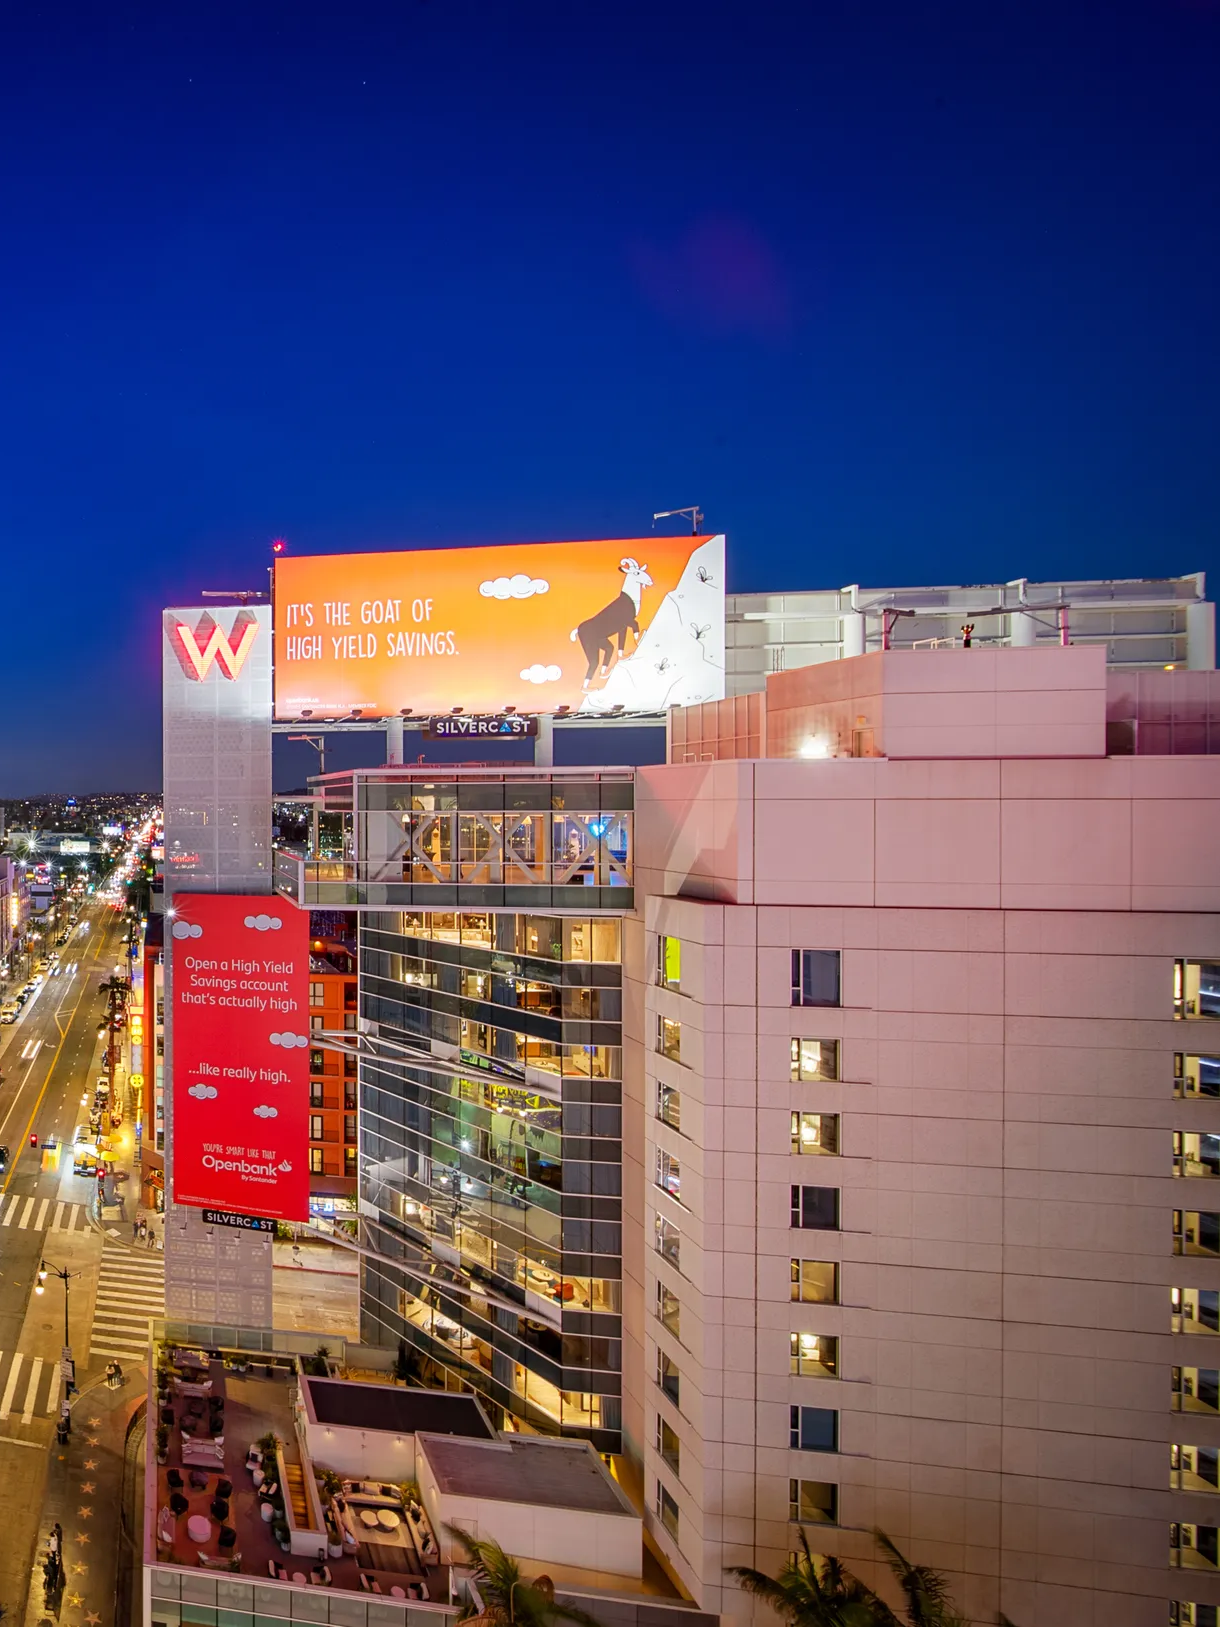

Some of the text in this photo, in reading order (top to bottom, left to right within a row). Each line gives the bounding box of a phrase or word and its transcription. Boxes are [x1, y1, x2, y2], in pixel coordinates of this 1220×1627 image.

[286, 598, 433, 628] IT'S THE GOAT OF
[174, 620, 260, 682] W
[286, 630, 460, 661] HIGH YIELD SAVINGS.
[185, 956, 294, 975] Open a High Yield
[190, 974, 288, 992] Savings account
[181, 992, 298, 1013] that's actually high
[223, 1067, 257, 1082] really
[260, 1068, 291, 1084] high.
[203, 1143, 276, 1159] YOU'RE SMART LIKE THAT
[202, 1155, 277, 1176] Openbank
[241, 1174, 277, 1184] By Santander
